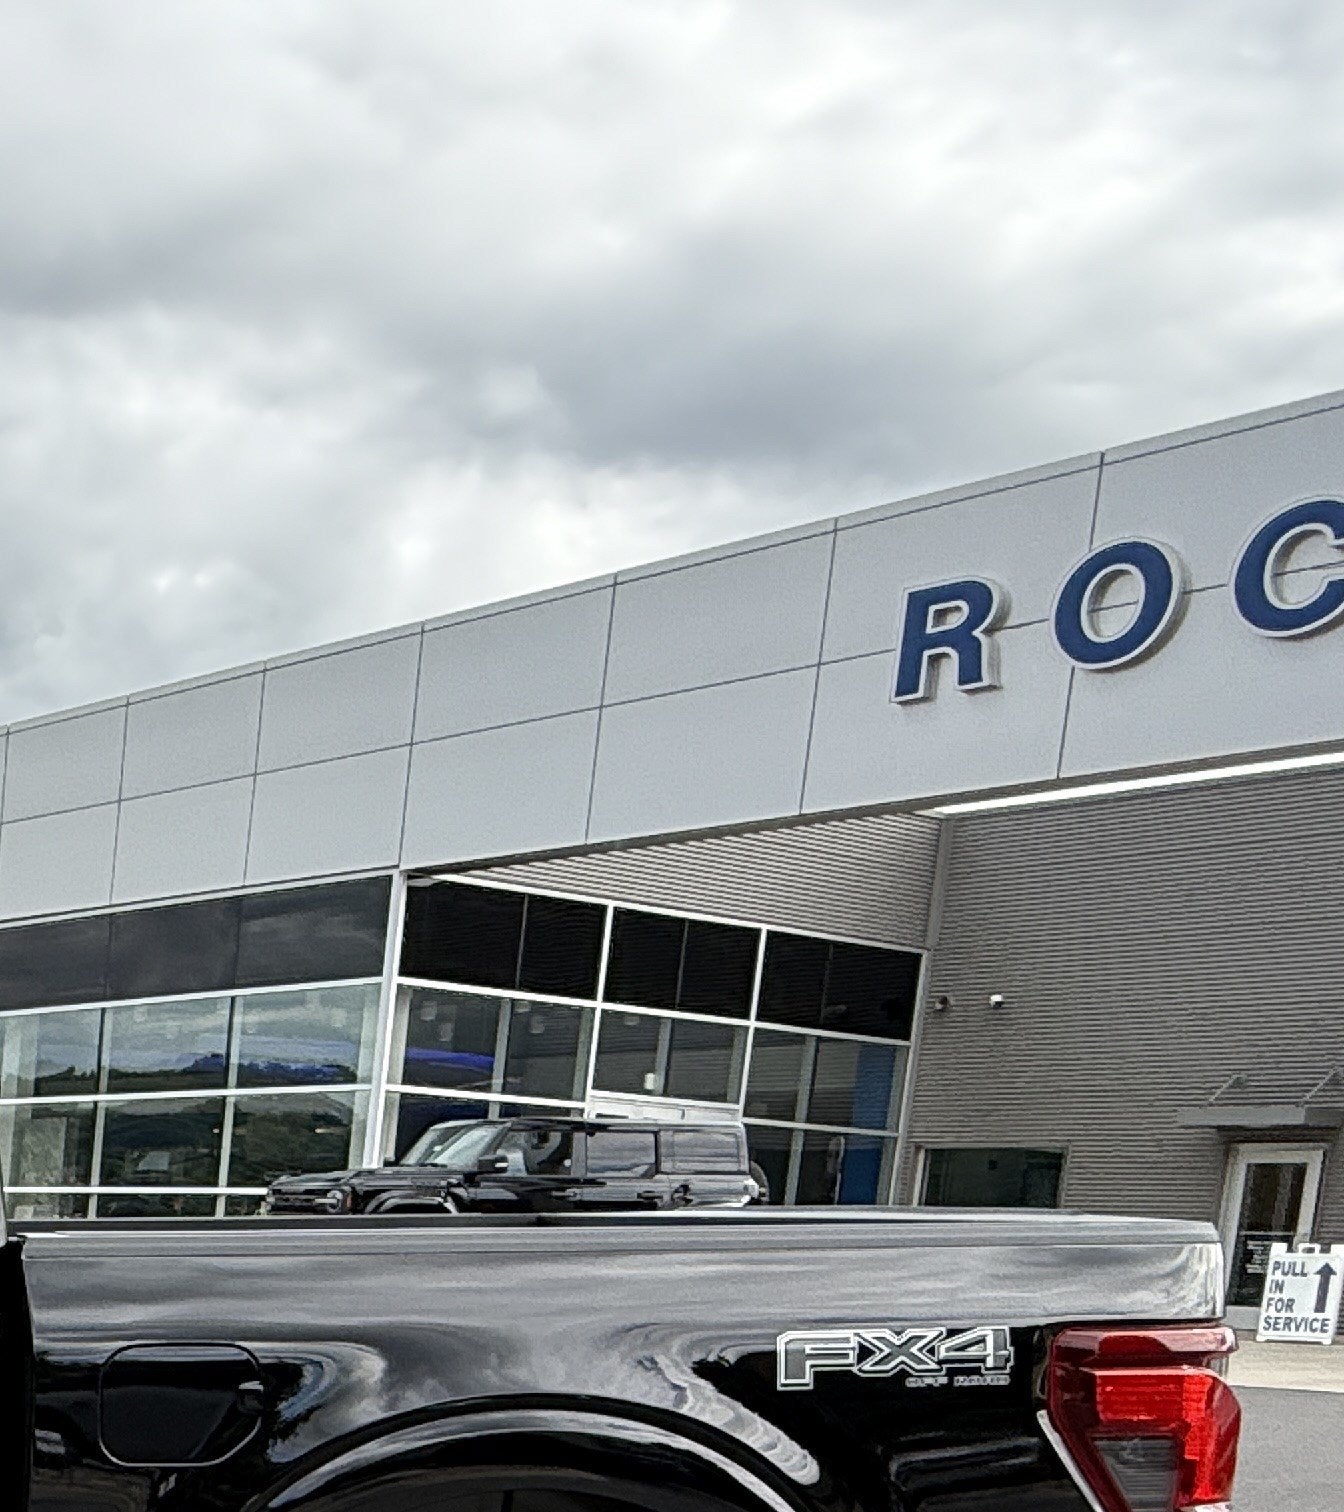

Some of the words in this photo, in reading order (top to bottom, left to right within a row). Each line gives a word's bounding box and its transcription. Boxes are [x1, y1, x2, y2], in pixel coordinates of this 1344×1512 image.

[1272, 1260, 1308, 1277] PULL
[1268, 1279, 1286, 1294] IN
[1265, 1297, 1296, 1313] FOR
[1262, 1315, 1331, 1333] SERVICE
[777, 1326, 1013, 1390] FX4
